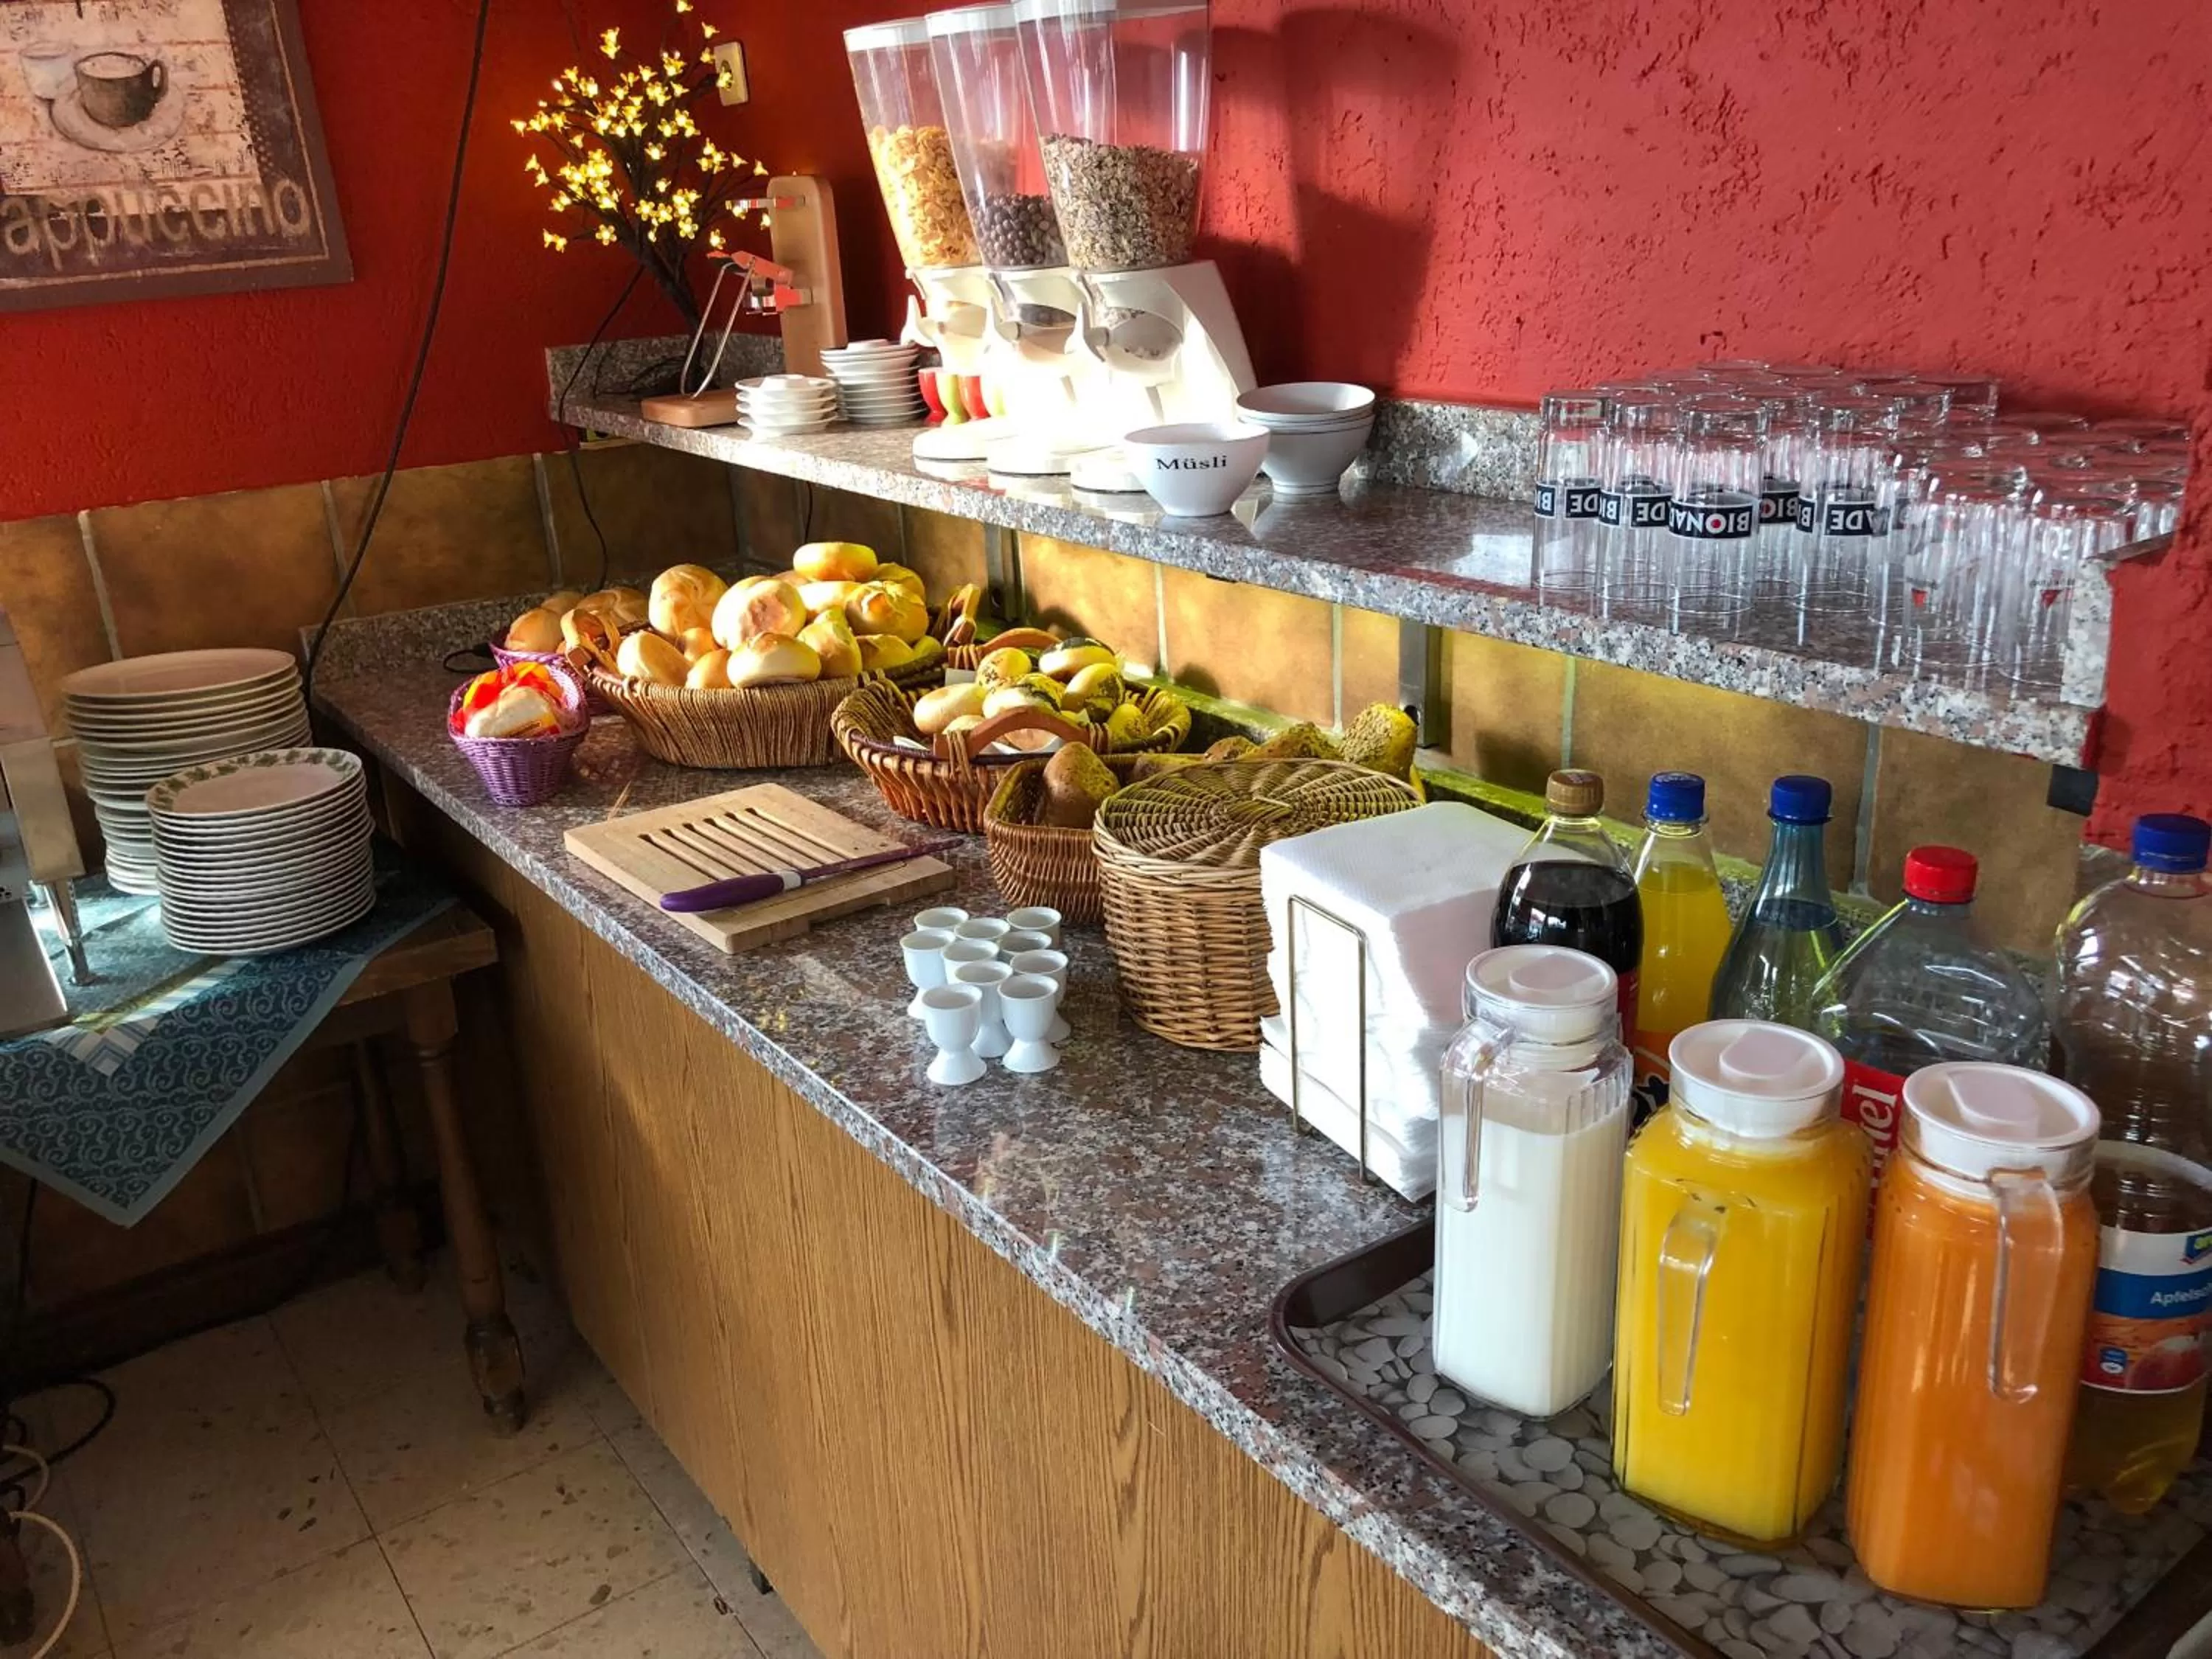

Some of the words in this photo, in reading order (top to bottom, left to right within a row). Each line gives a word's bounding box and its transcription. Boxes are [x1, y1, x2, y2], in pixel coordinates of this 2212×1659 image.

[1156, 456, 1227, 470] Müsli
[1636, 501, 1667, 522] DE
[1669, 504, 1750, 534] BIONA
